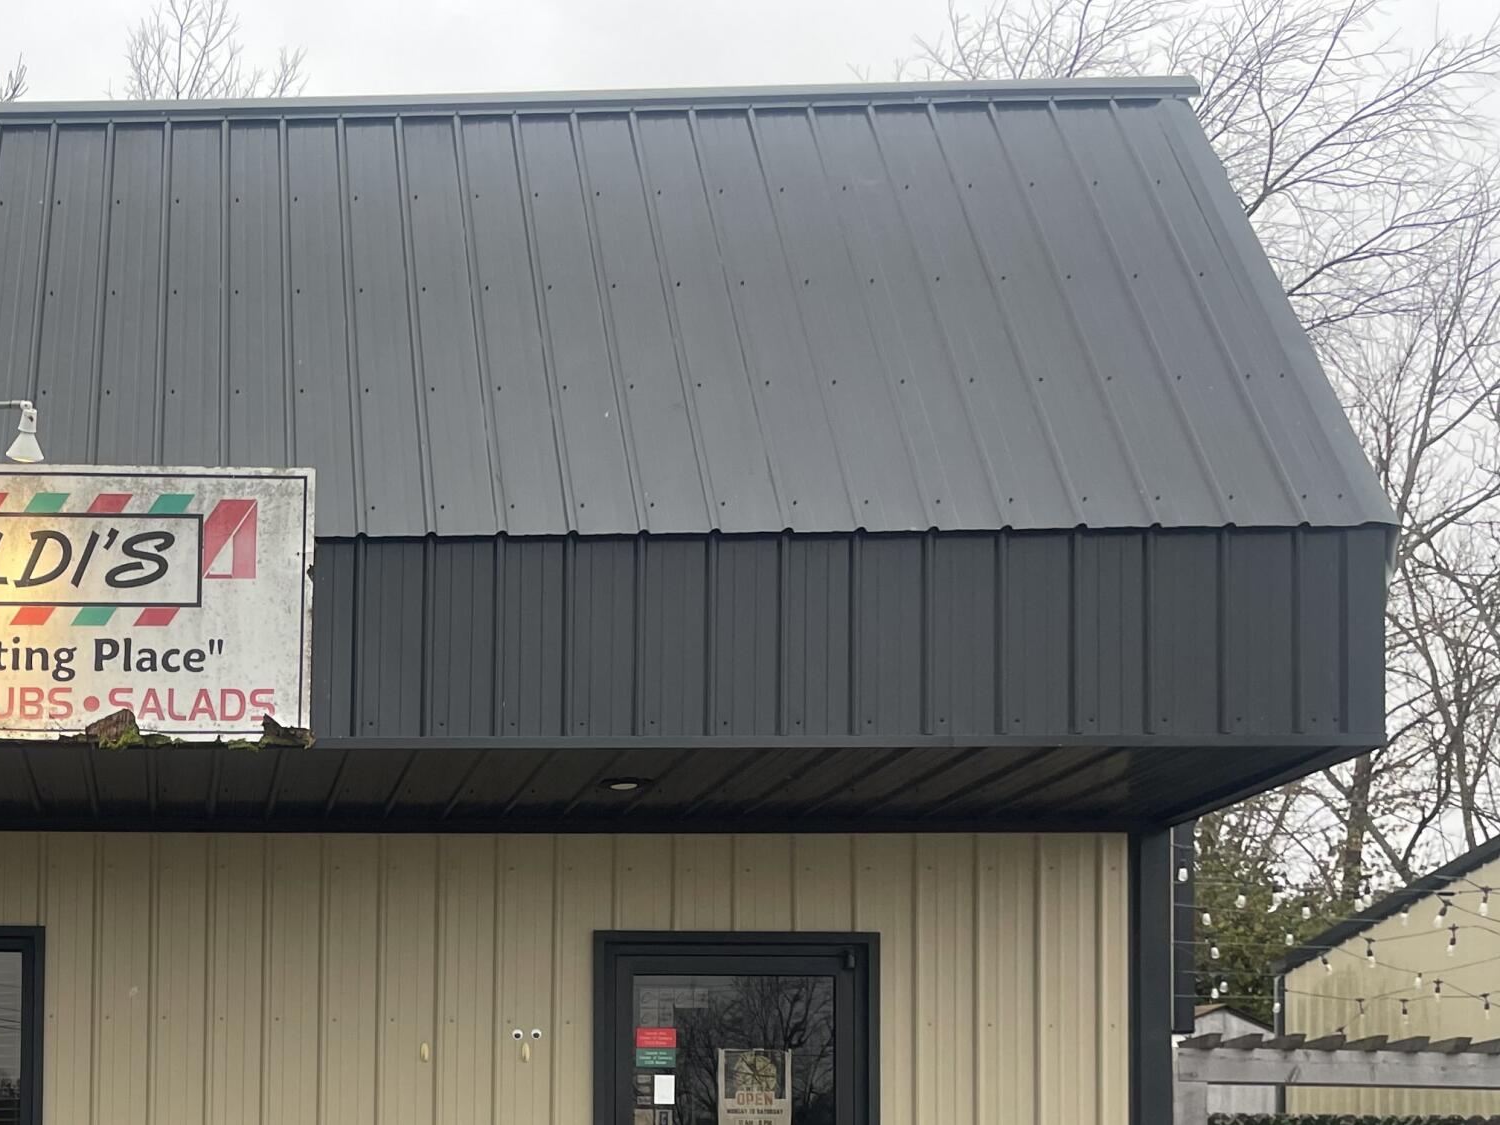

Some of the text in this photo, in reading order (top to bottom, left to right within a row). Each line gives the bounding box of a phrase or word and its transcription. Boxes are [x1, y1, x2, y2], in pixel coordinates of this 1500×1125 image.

[94, 637, 224, 672] Place"
[108, 688, 276, 722] SALADS
[737, 1092, 773, 1106] OPEN
